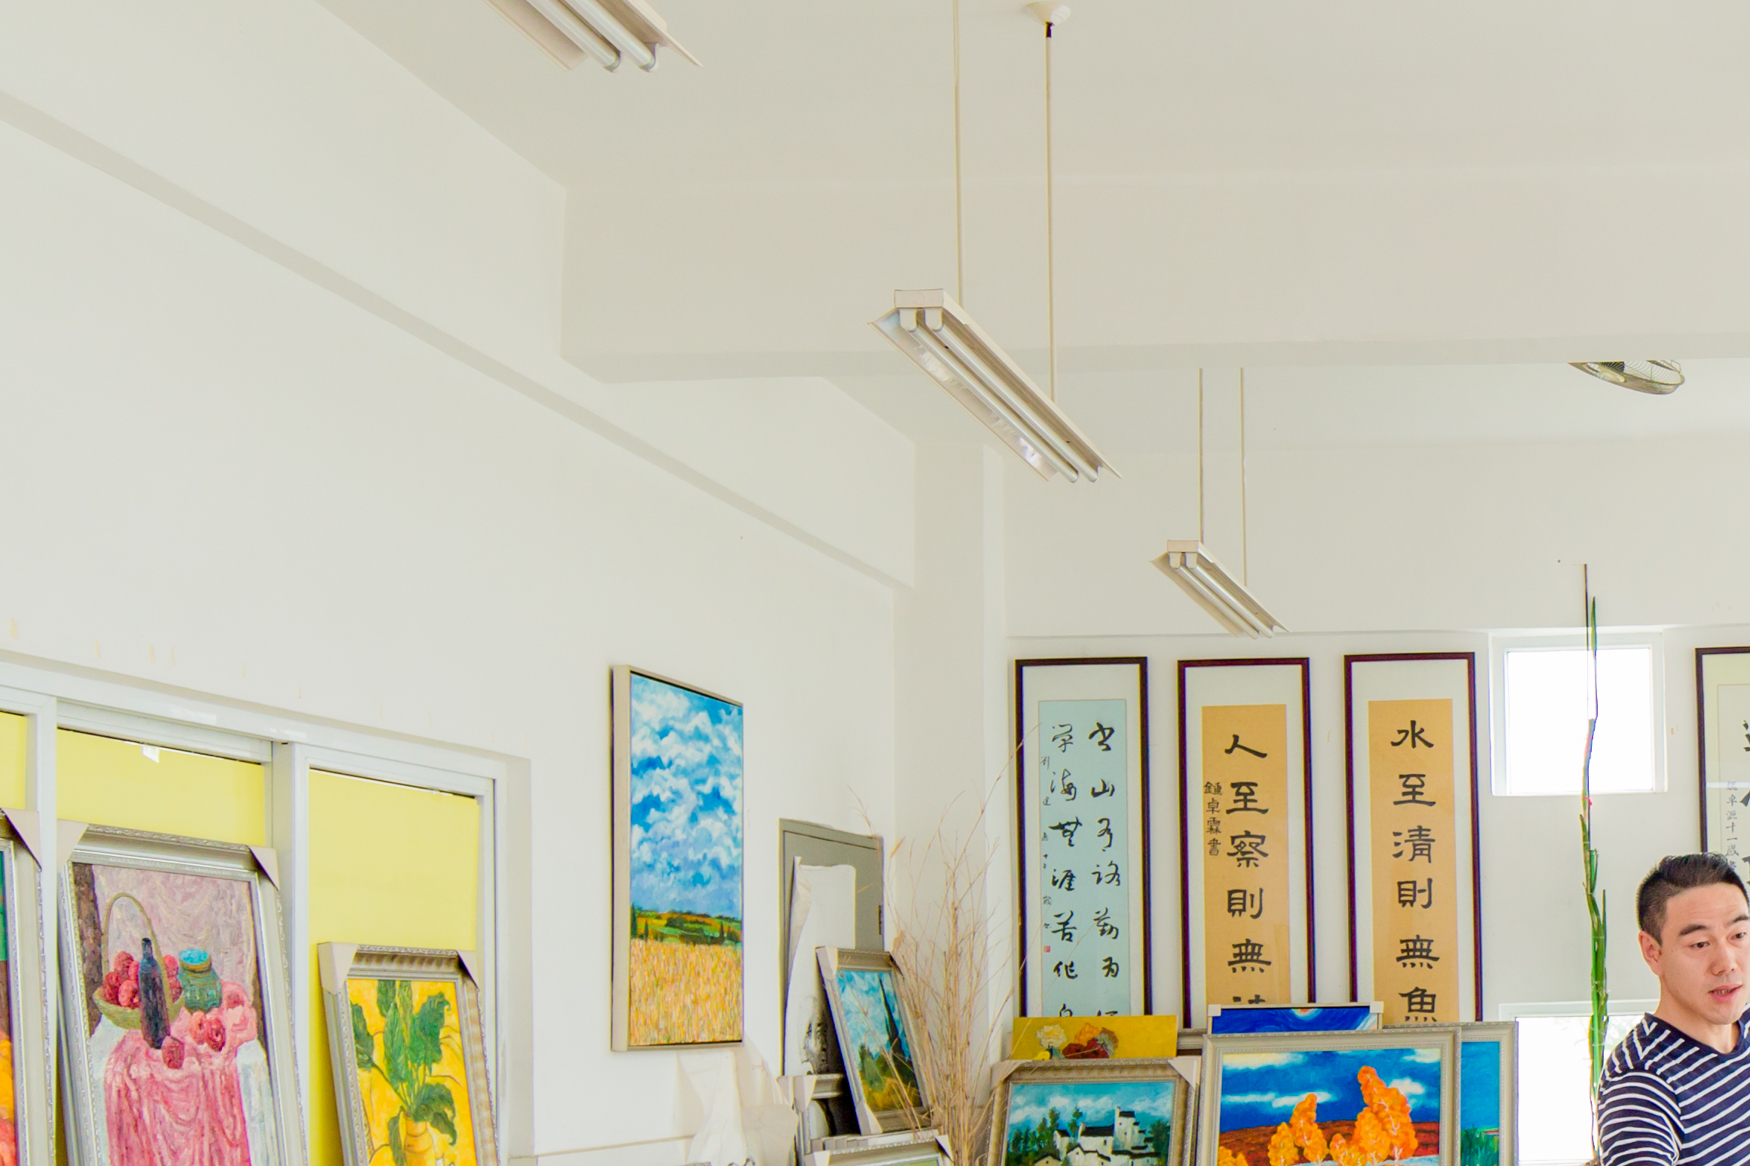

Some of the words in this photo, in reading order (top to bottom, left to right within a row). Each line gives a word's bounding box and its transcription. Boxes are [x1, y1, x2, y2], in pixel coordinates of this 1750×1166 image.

[1224, 733, 1274, 1004] 人至察則無
